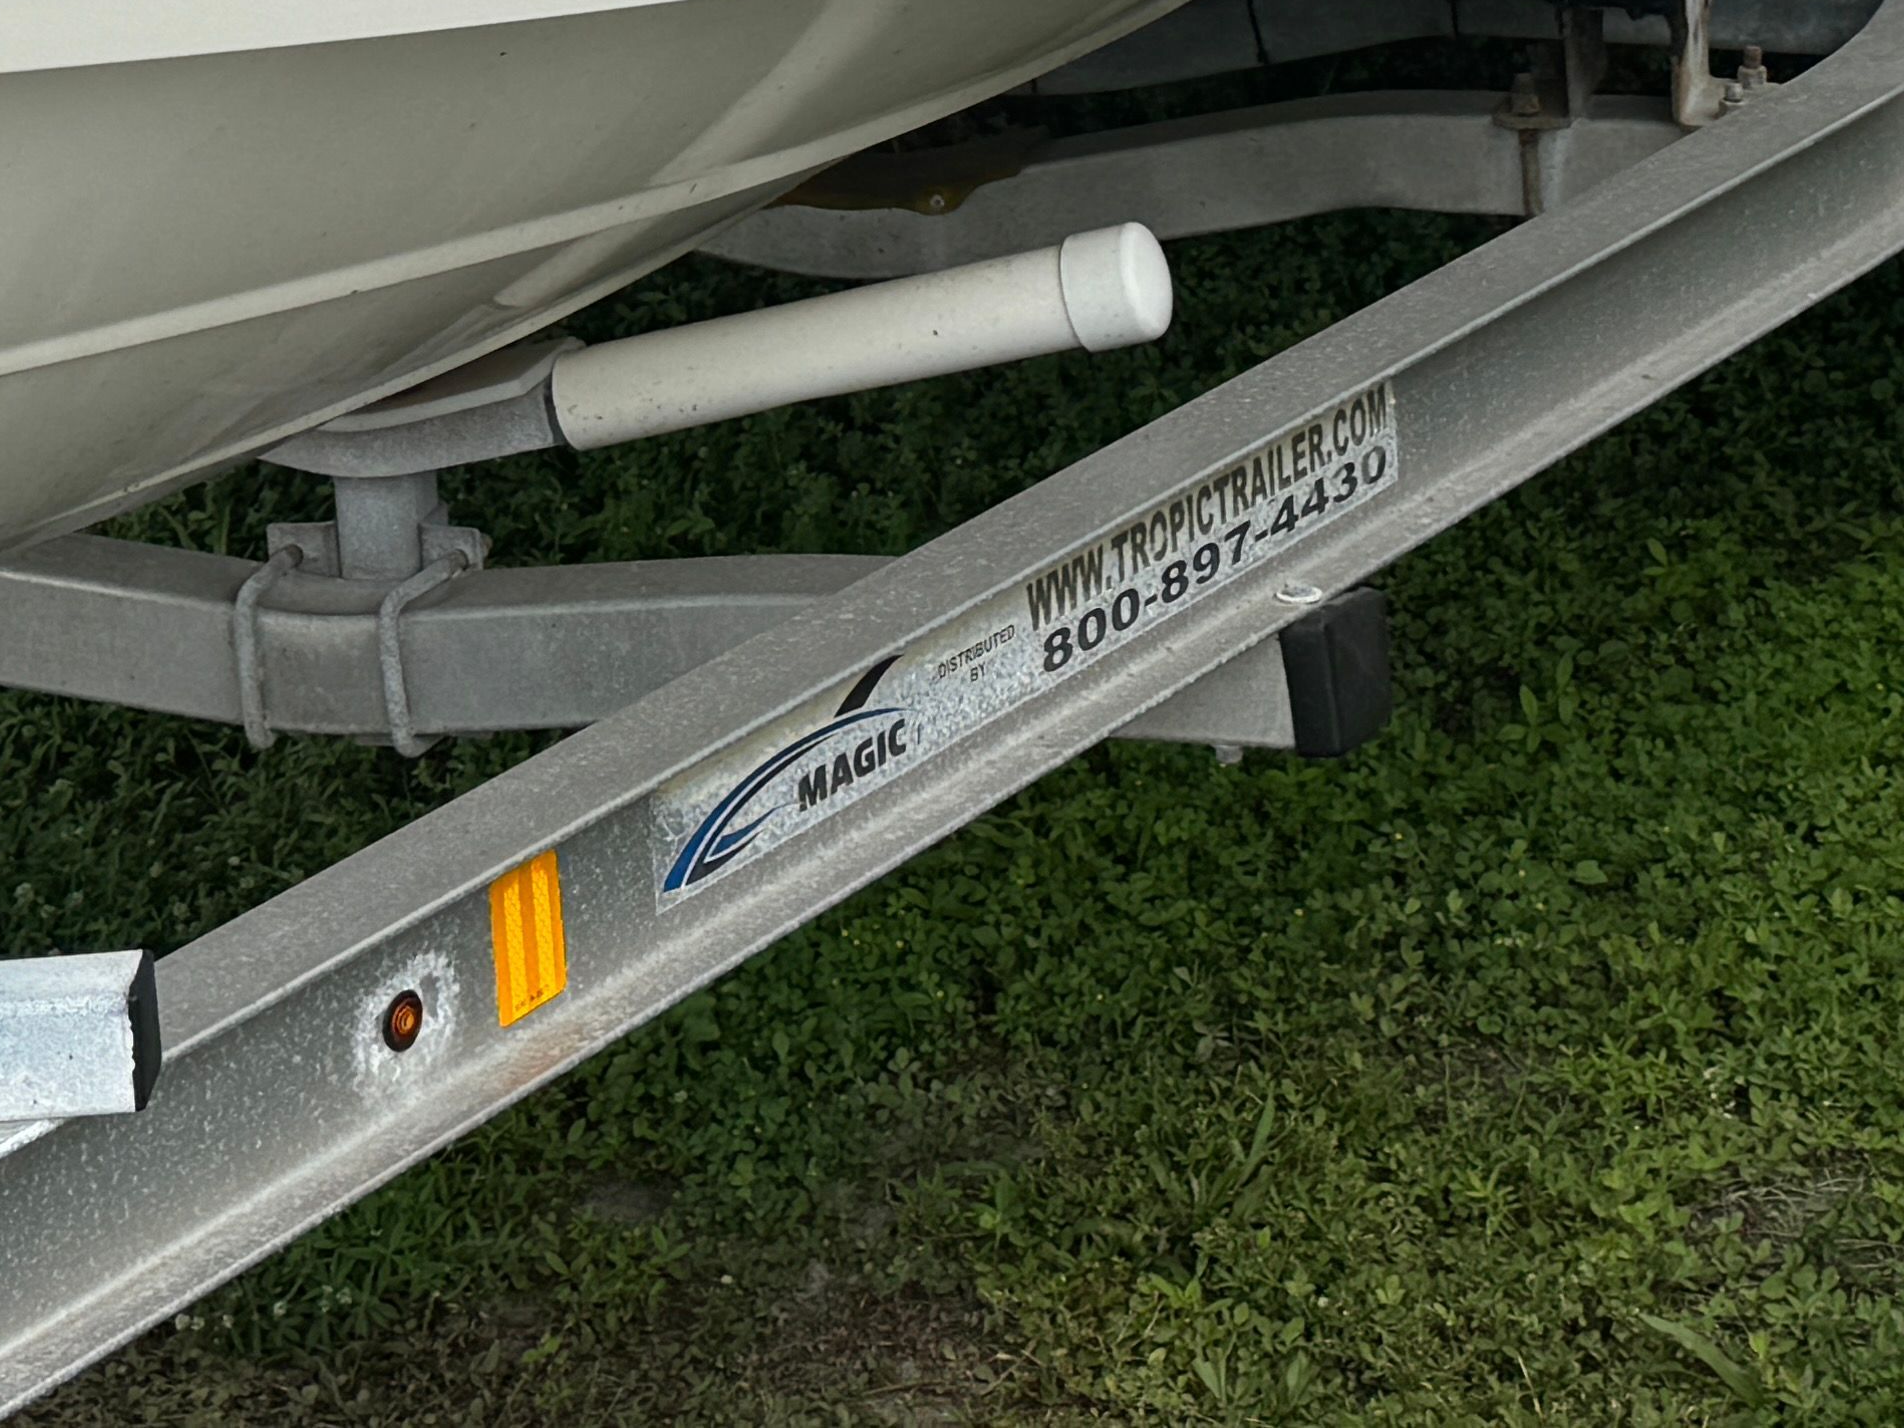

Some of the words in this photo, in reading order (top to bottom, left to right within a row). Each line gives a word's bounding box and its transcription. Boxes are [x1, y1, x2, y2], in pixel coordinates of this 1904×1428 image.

[1026, 385, 1387, 631] WWW.TROPICTRAILER.COM
[1043, 446, 1387, 672] 800-897-4430
[937, 624, 1015, 679] DISTRIBUTED
[970, 662, 986, 682] BY
[798, 718, 907, 813] MAGIC
